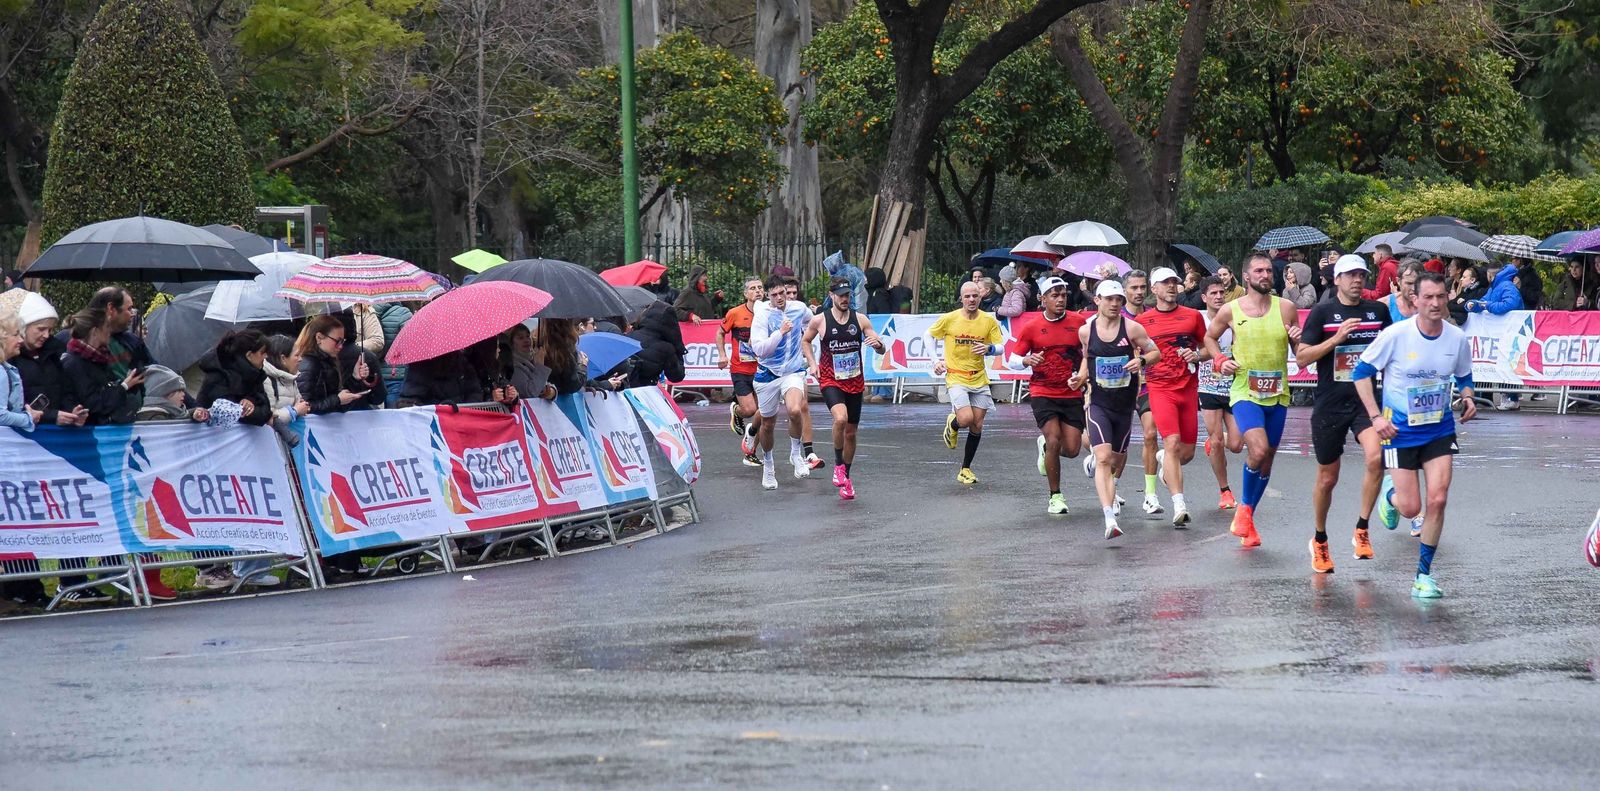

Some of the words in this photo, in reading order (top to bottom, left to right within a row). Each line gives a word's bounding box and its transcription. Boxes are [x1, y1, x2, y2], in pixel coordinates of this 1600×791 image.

[1466, 336, 1499, 360] ATE
[1544, 339, 1600, 363] CREAT
[1101, 365, 1123, 375] 2360
[1346, 354, 1361, 366] 29
[1257, 379, 1275, 389] 927
[1414, 393, 1441, 407] 2007
[549, 436, 590, 475] CREATE
[466, 446, 528, 489] CREATE
[350, 457, 430, 504] CREATE
[0, 478, 97, 521] REATE
[180, 473, 282, 517] CREATE
[369, 513, 388, 527] Acción
[387, 511, 409, 525] Creativa
[409, 509, 418, 521] de
[416, 508, 438, 520] Eventos
[27, 534, 60, 546] Creativa
[61, 533, 72, 545] de
[72, 532, 104, 545] Eventos
[196, 527, 221, 539] Acción
[221, 527, 249, 539] Creativa
[250, 528, 260, 540] de
[259, 529, 289, 541] Eventos
